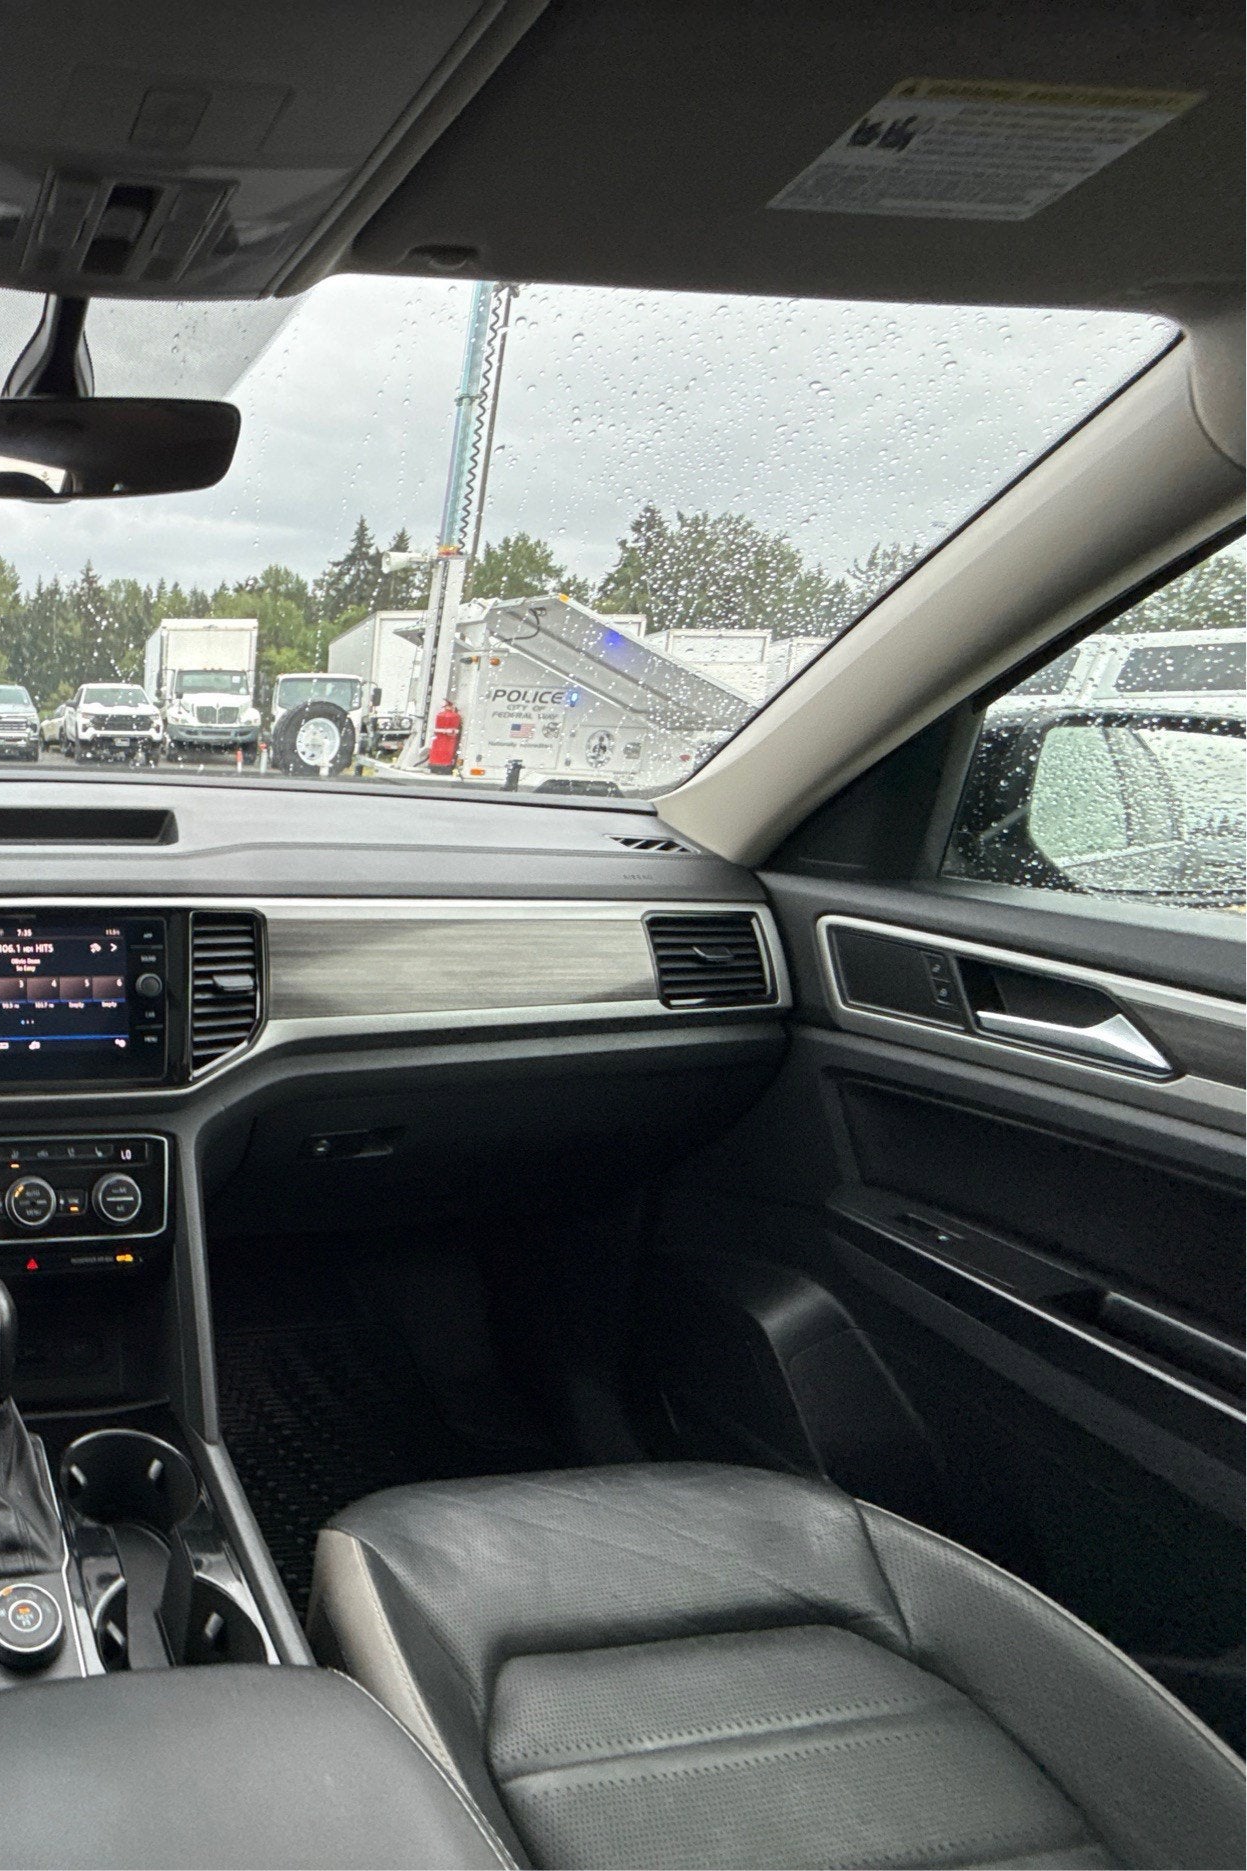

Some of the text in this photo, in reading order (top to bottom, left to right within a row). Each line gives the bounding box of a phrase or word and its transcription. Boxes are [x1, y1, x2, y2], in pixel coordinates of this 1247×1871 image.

[492, 689, 564, 704] POLICE
[492, 711, 533, 719] FEDERAL
[35, 943, 54, 953] HITS
[120, 1149, 132, 1160] LO
